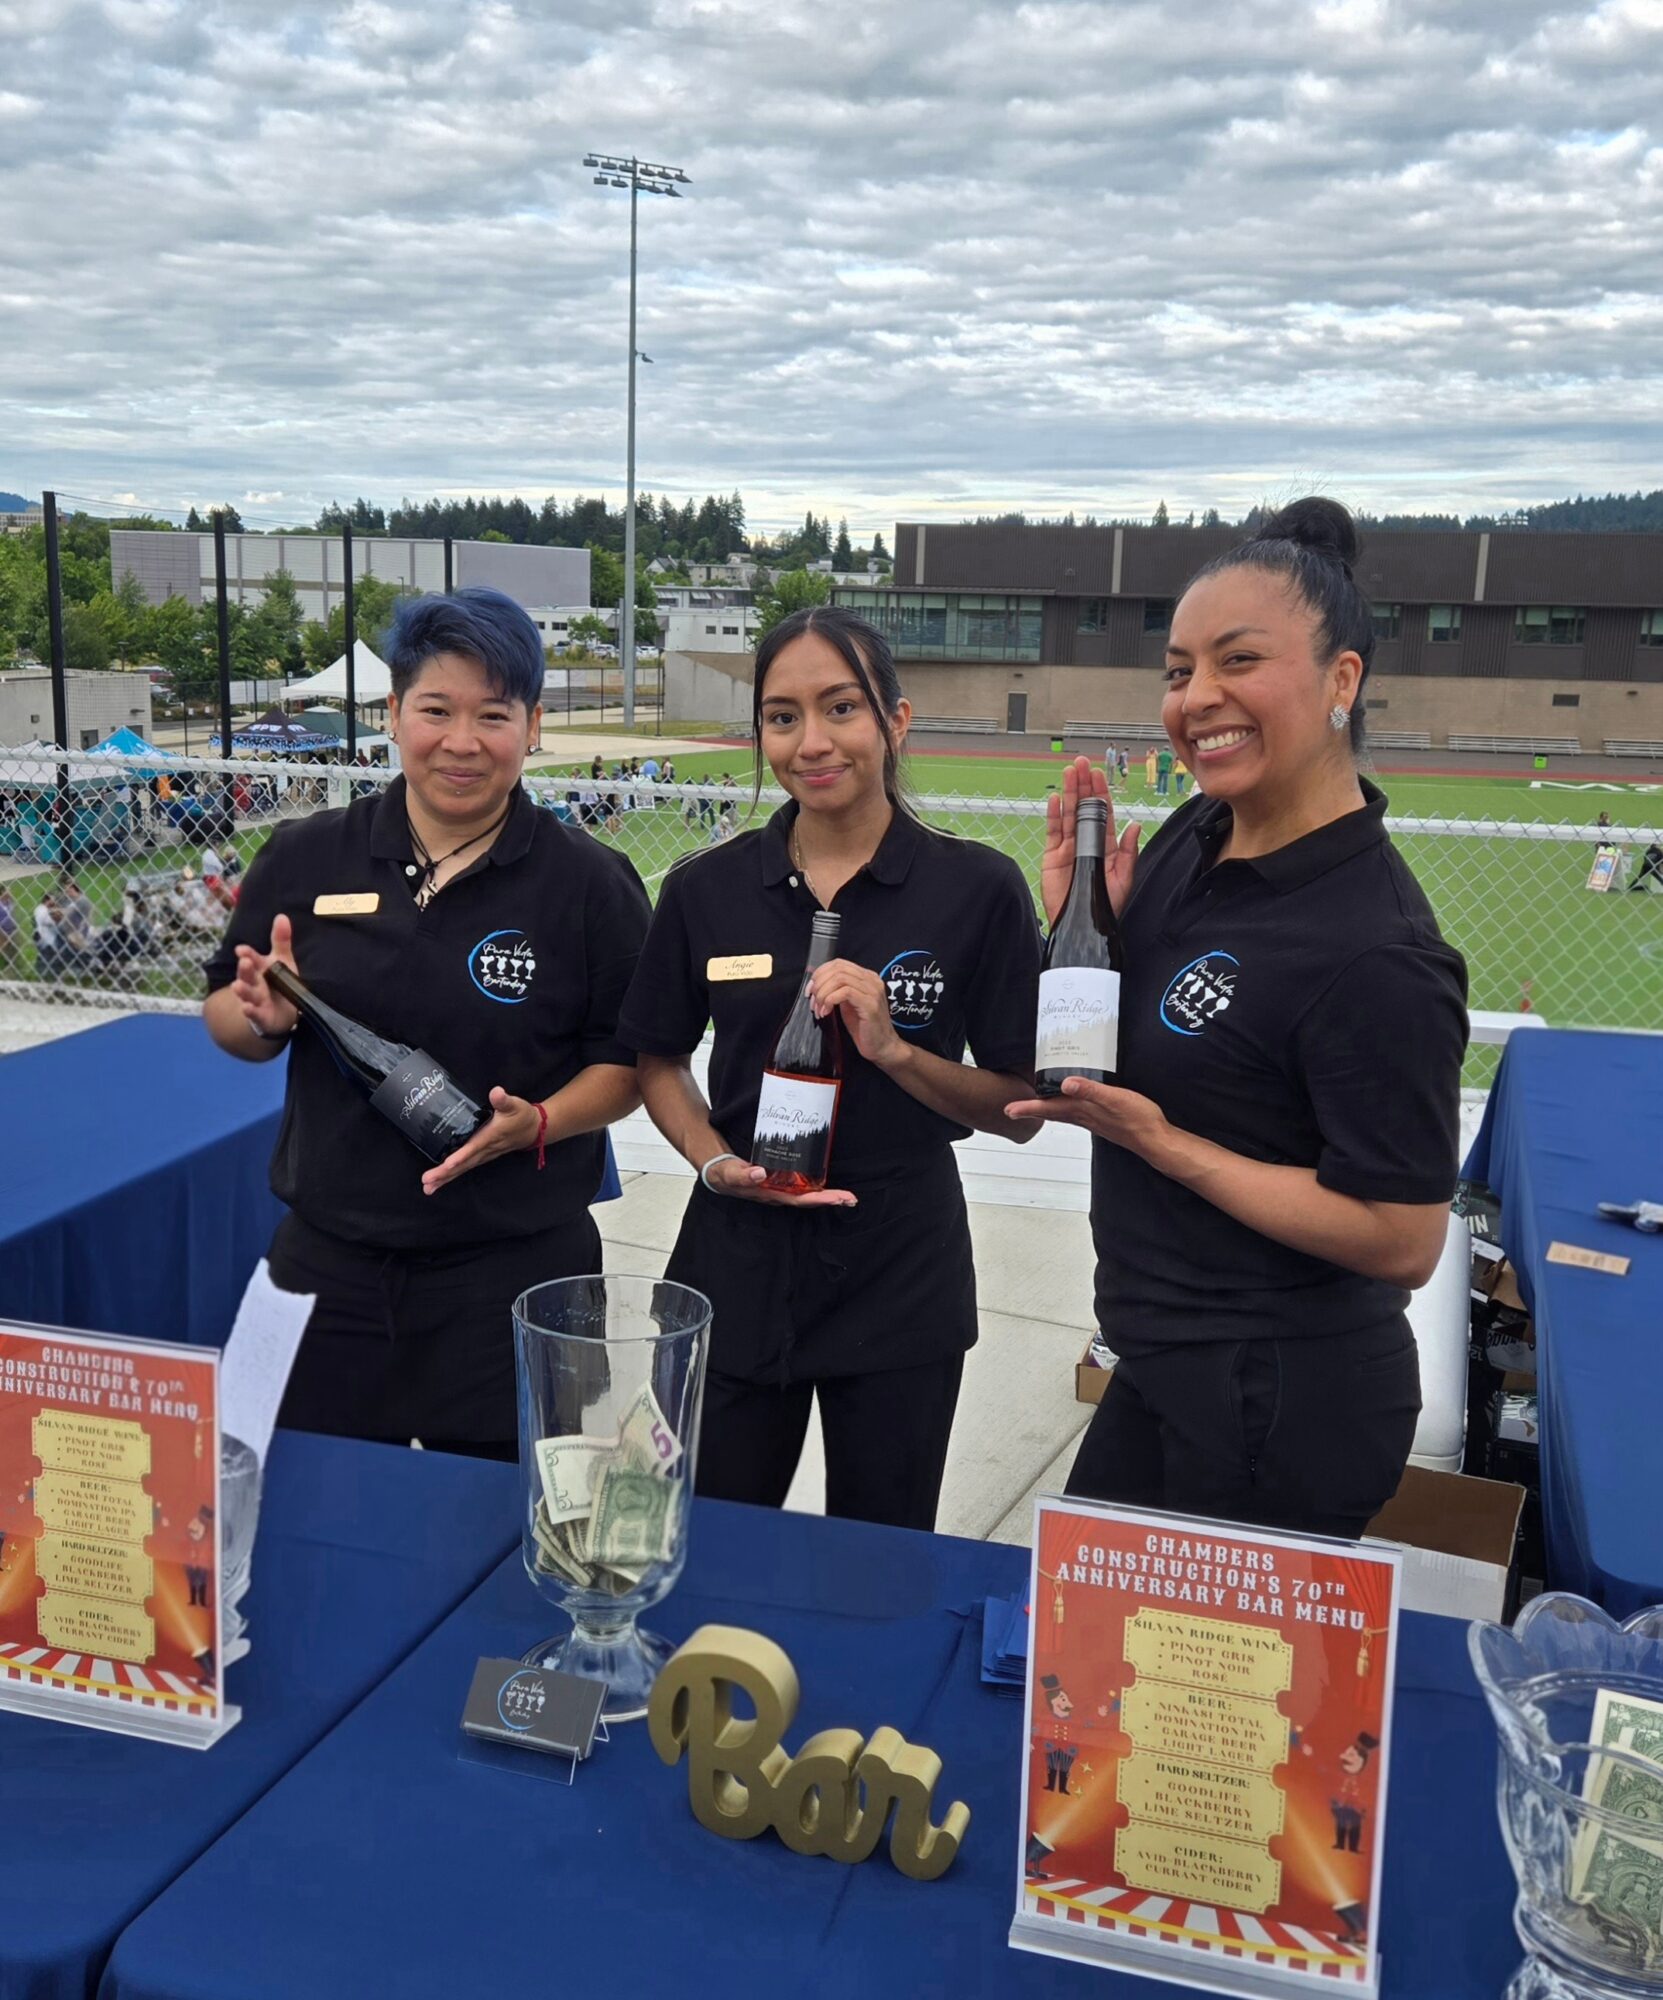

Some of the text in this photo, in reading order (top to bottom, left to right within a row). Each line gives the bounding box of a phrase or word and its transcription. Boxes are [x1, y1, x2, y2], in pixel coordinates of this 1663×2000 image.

[109, 1392, 142, 1411] BAR
[150, 1397, 198, 1421] MENU
[65, 1436, 97, 1448] PINOT
[77, 1425, 109, 1436] RIDGE
[651, 1420, 673, 1460] 5
[66, 1447, 95, 1457] PINOT
[80, 1480, 112, 1493] BEER:
[65, 1519, 94, 1529] LIGHT
[105, 1516, 131, 1526] BEER
[61, 1540, 86, 1551] HARD
[1145, 1534, 1275, 1572] CHAMBERS
[55, 1574, 133, 1594] LIME SELTZER
[62, 1564, 132, 1583] BLACKBERRY
[1077, 1544, 1346, 1601] CONSTRUCTION'S 70TH
[1056, 1562, 1366, 1630] ANNIVERSARY BAR MENU
[78, 1609, 114, 1623] CIDER:
[59, 1626, 136, 1647] CURRANT CIDER
[1134, 1617, 1287, 1654] SILVAN RIDGE WINE:
[1170, 1641, 1256, 1664] PINOT GRIS
[1171, 1653, 1251, 1675] PINOT NOIR
[1188, 1694, 1232, 1711] BEER:
[1154, 1712, 1266, 1742] DOMINATION IPA
[1159, 1702, 1264, 1729] NINKASI TOTAL
[1162, 1727, 1257, 1752] GARAGE BEER
[1163, 1738, 1255, 1763] LIGHT LAGER
[648, 1624, 971, 1881] Bar
[1156, 1762, 1251, 1789] HARD SELTZER:
[1168, 1781, 1241, 1804] GOODLIFE
[1144, 1802, 1253, 1832] LIME SELTZER
[1155, 1791, 1252, 1819] BLACKBERRY
[1174, 1846, 1224, 1864] CIDER:
[1145, 1863, 1254, 1893] CURRANT CIDER
[1174, 1856, 1262, 1884] BLACKBERRY
